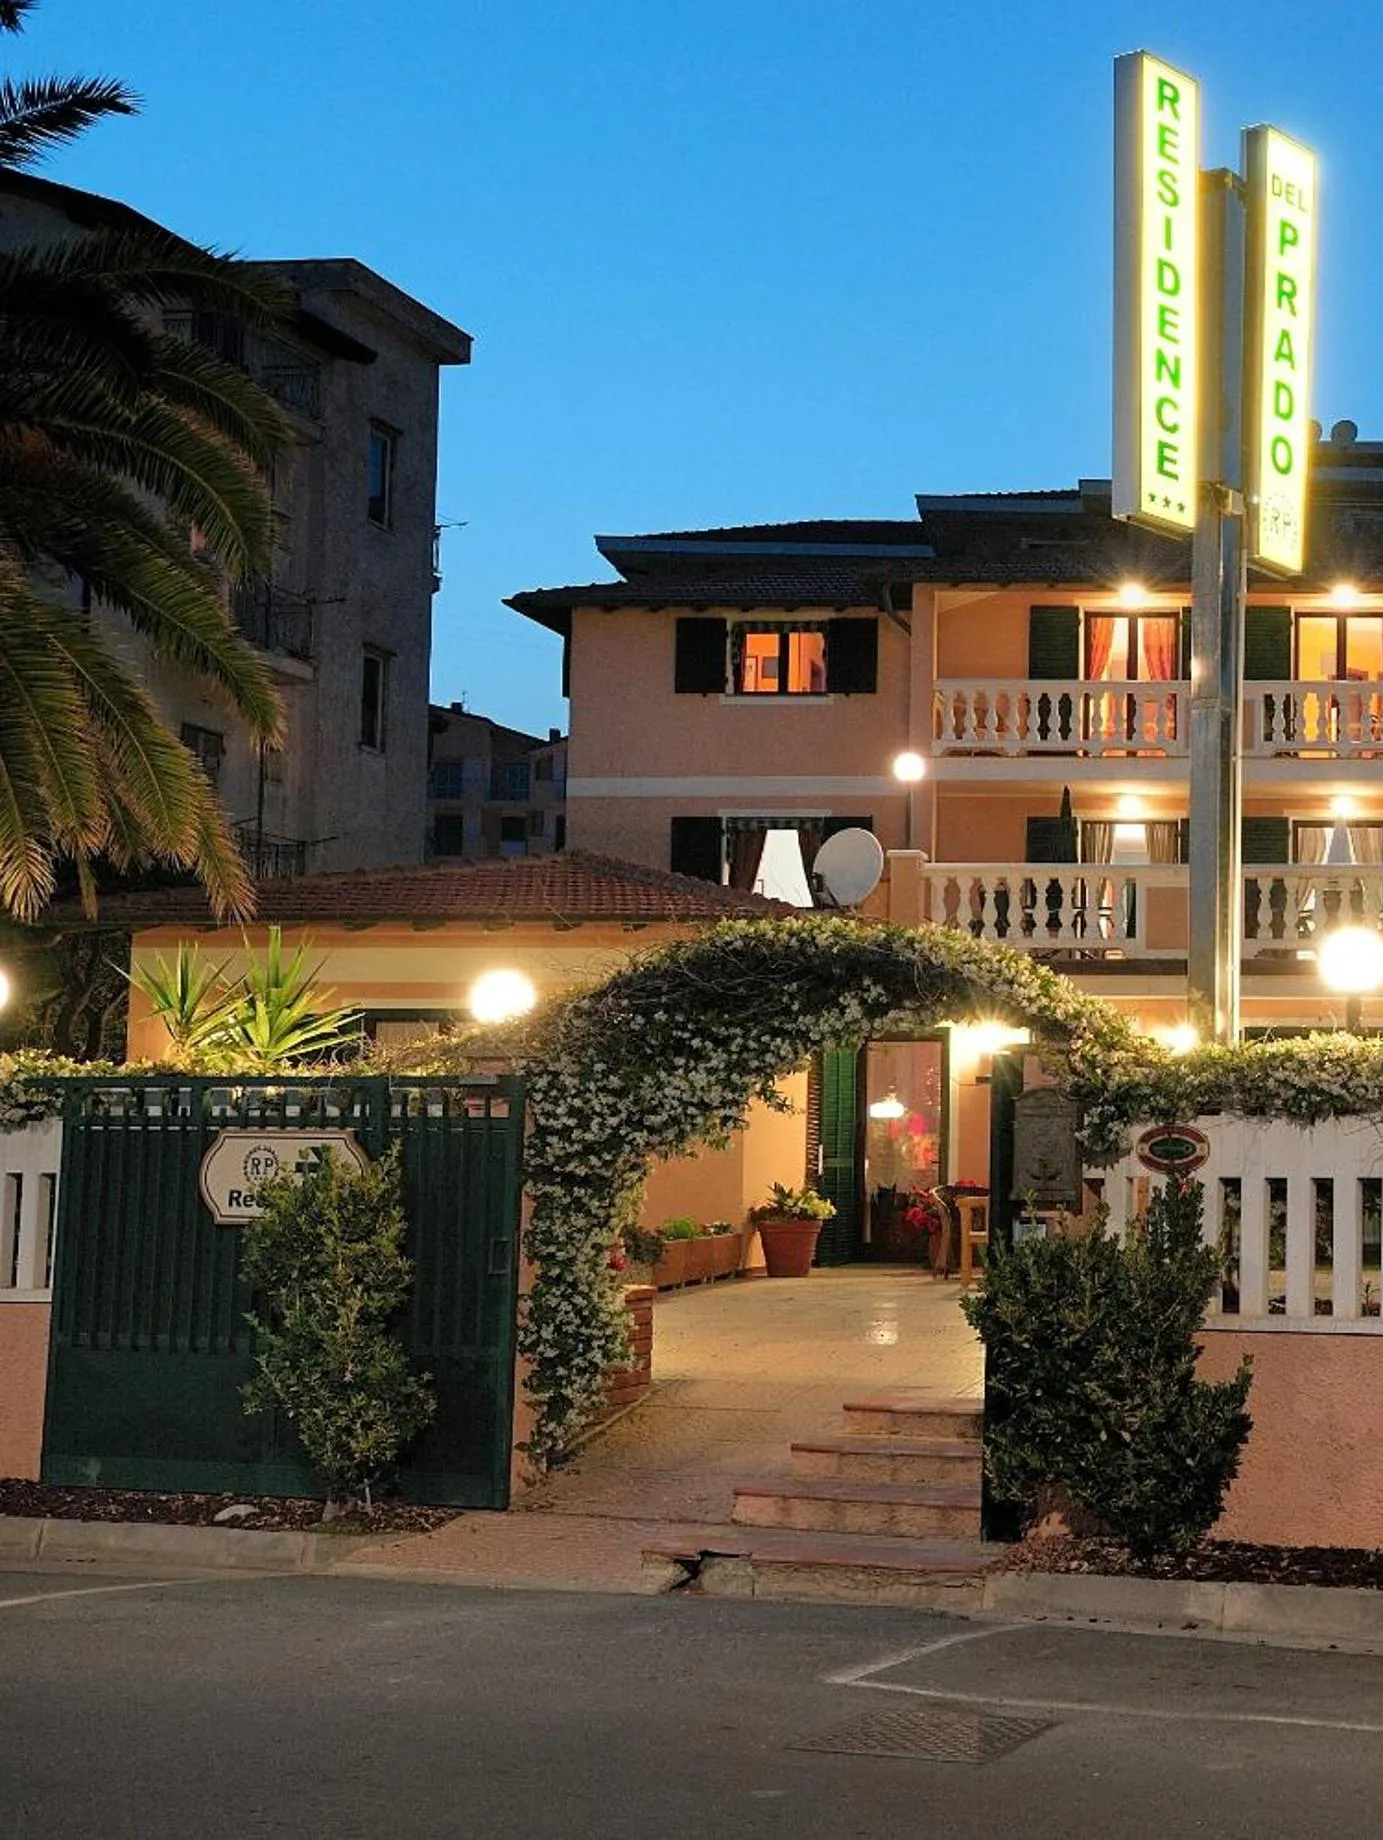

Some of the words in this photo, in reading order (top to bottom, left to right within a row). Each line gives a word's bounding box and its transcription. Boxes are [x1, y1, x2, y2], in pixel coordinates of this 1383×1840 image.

[1154, 76, 1182, 482] RESIDENCE
[1271, 173, 1309, 214] DEL
[1270, 217, 1299, 477] PRADO
